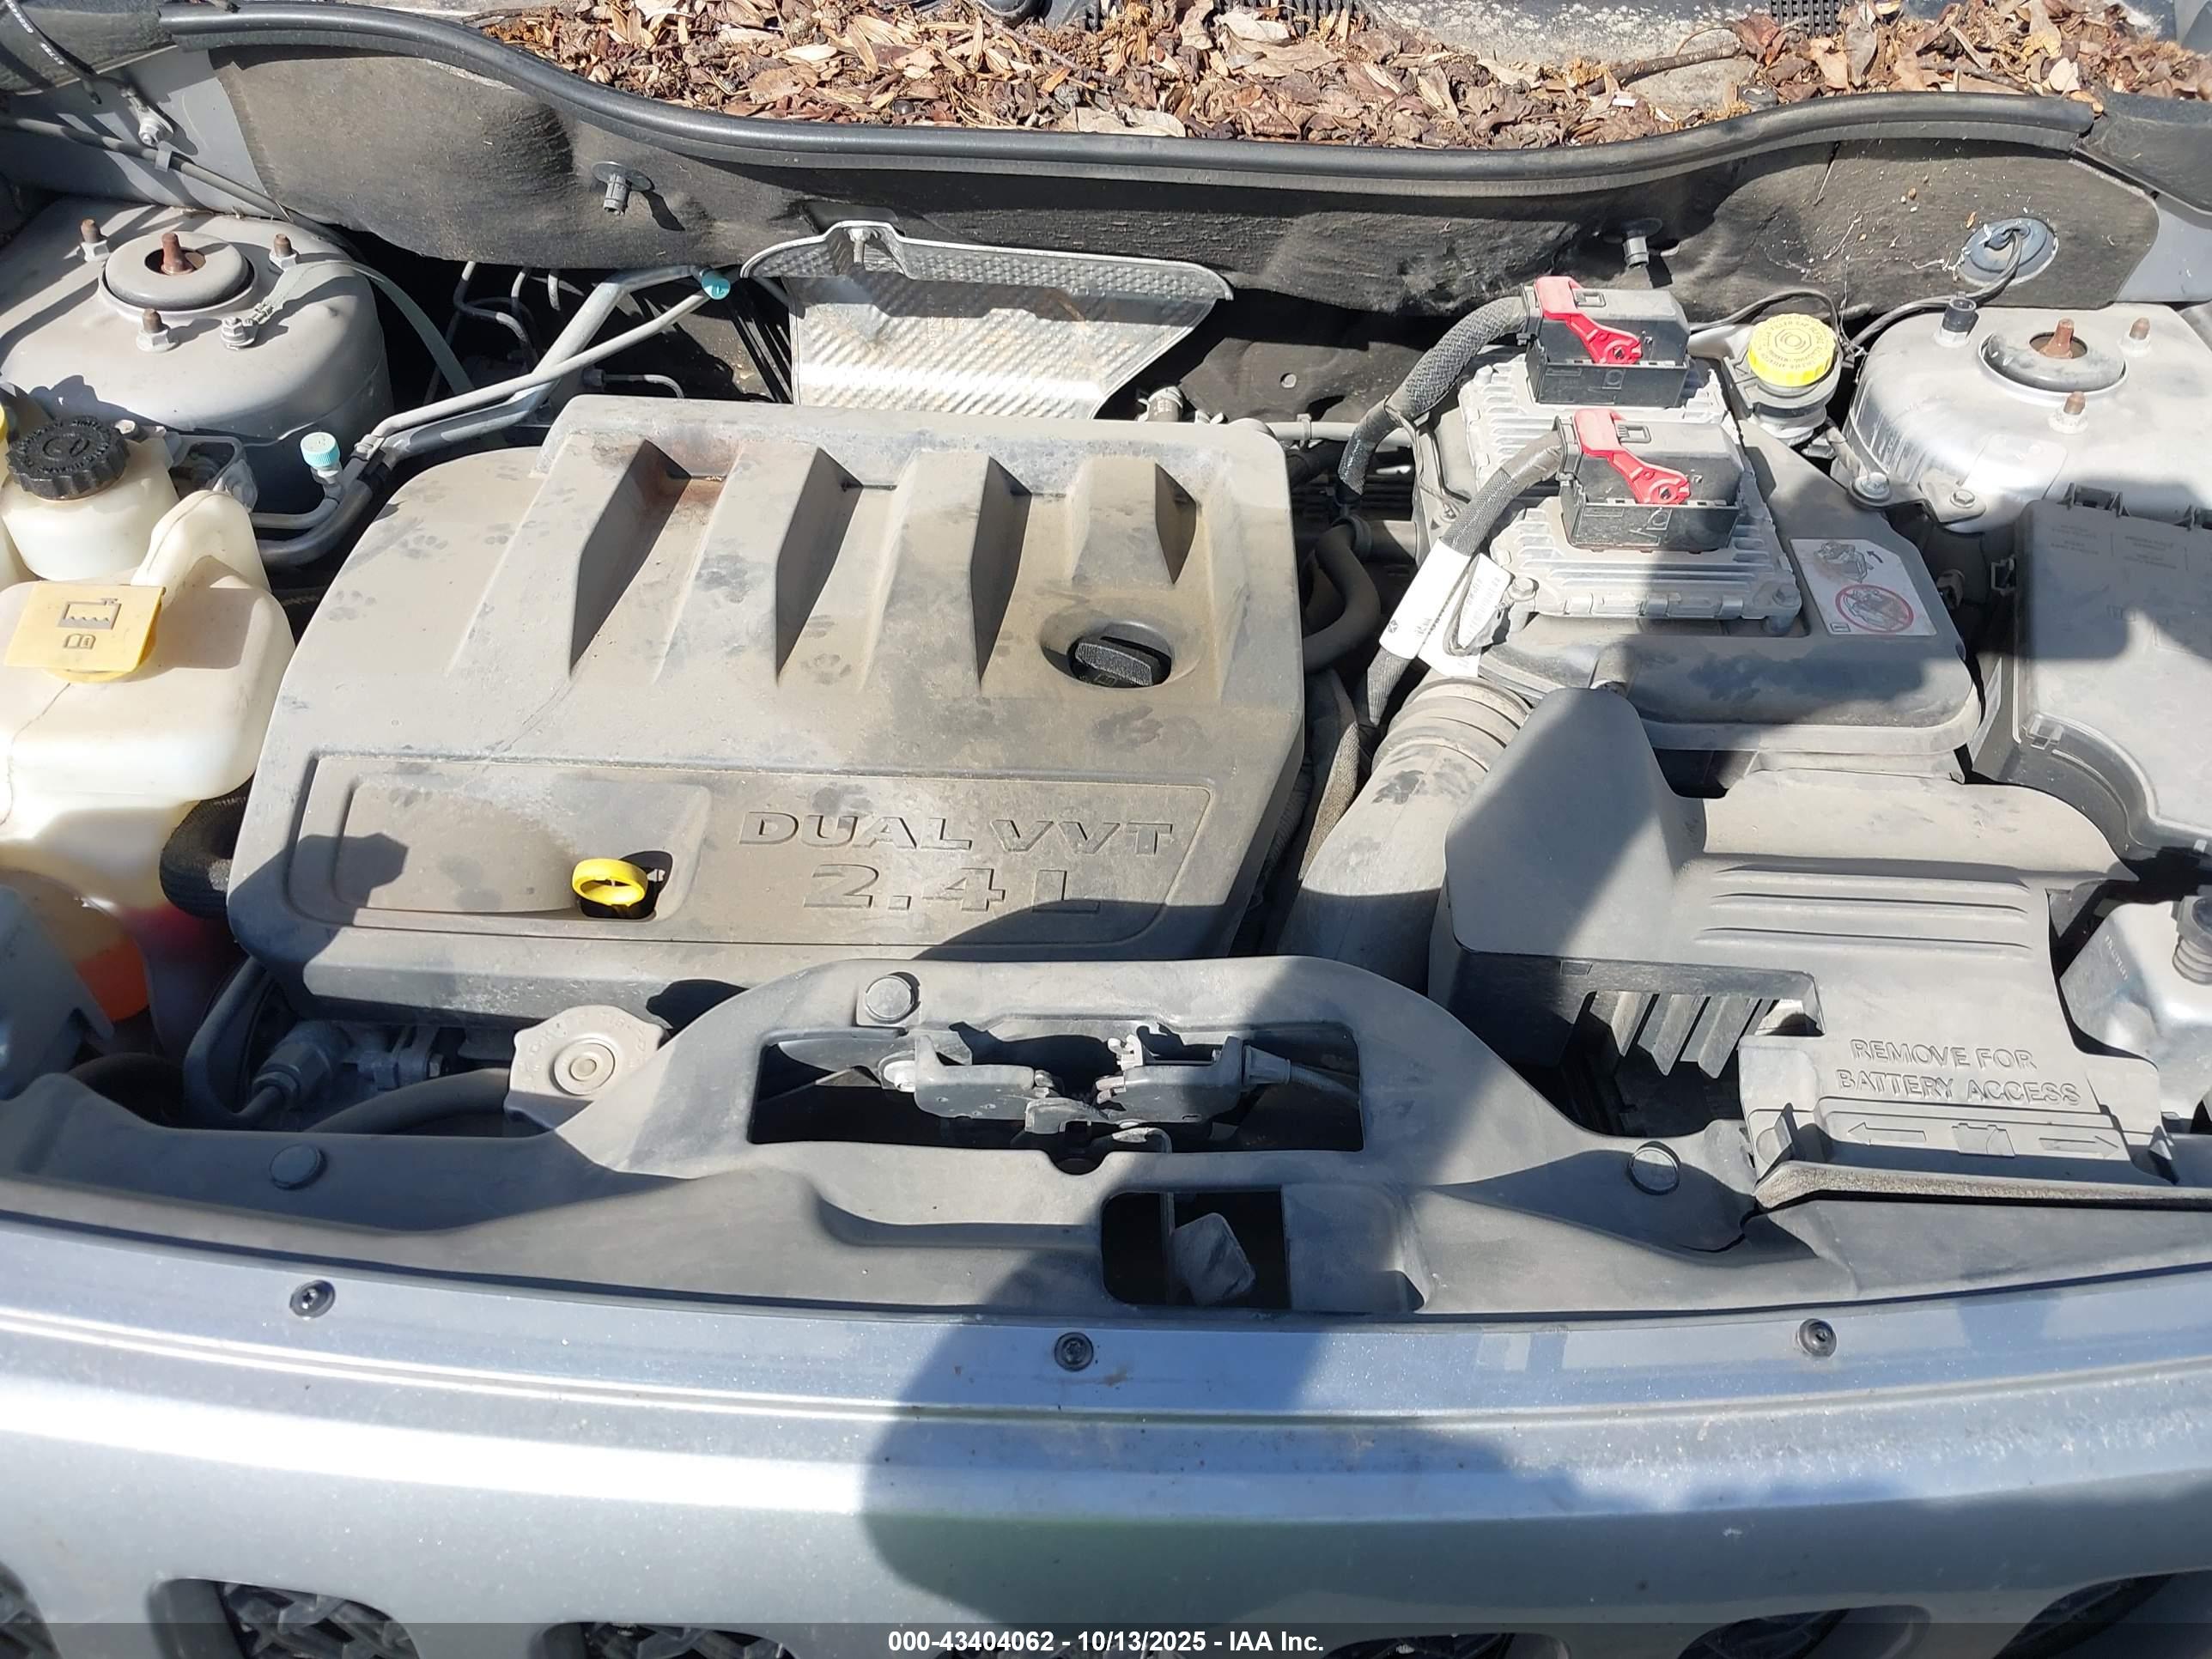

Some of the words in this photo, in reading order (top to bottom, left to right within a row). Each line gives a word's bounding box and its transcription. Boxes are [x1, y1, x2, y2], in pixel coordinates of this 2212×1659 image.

[738, 811, 972, 850] DUAL
[991, 818, 1173, 855] VVT
[1850, 1039, 1970, 1068] REMOVE
[1975, 1048, 2037, 1070] FOR
[1836, 1069, 1954, 1099] BATTERY
[1966, 1079, 2081, 1104] ACCESS
